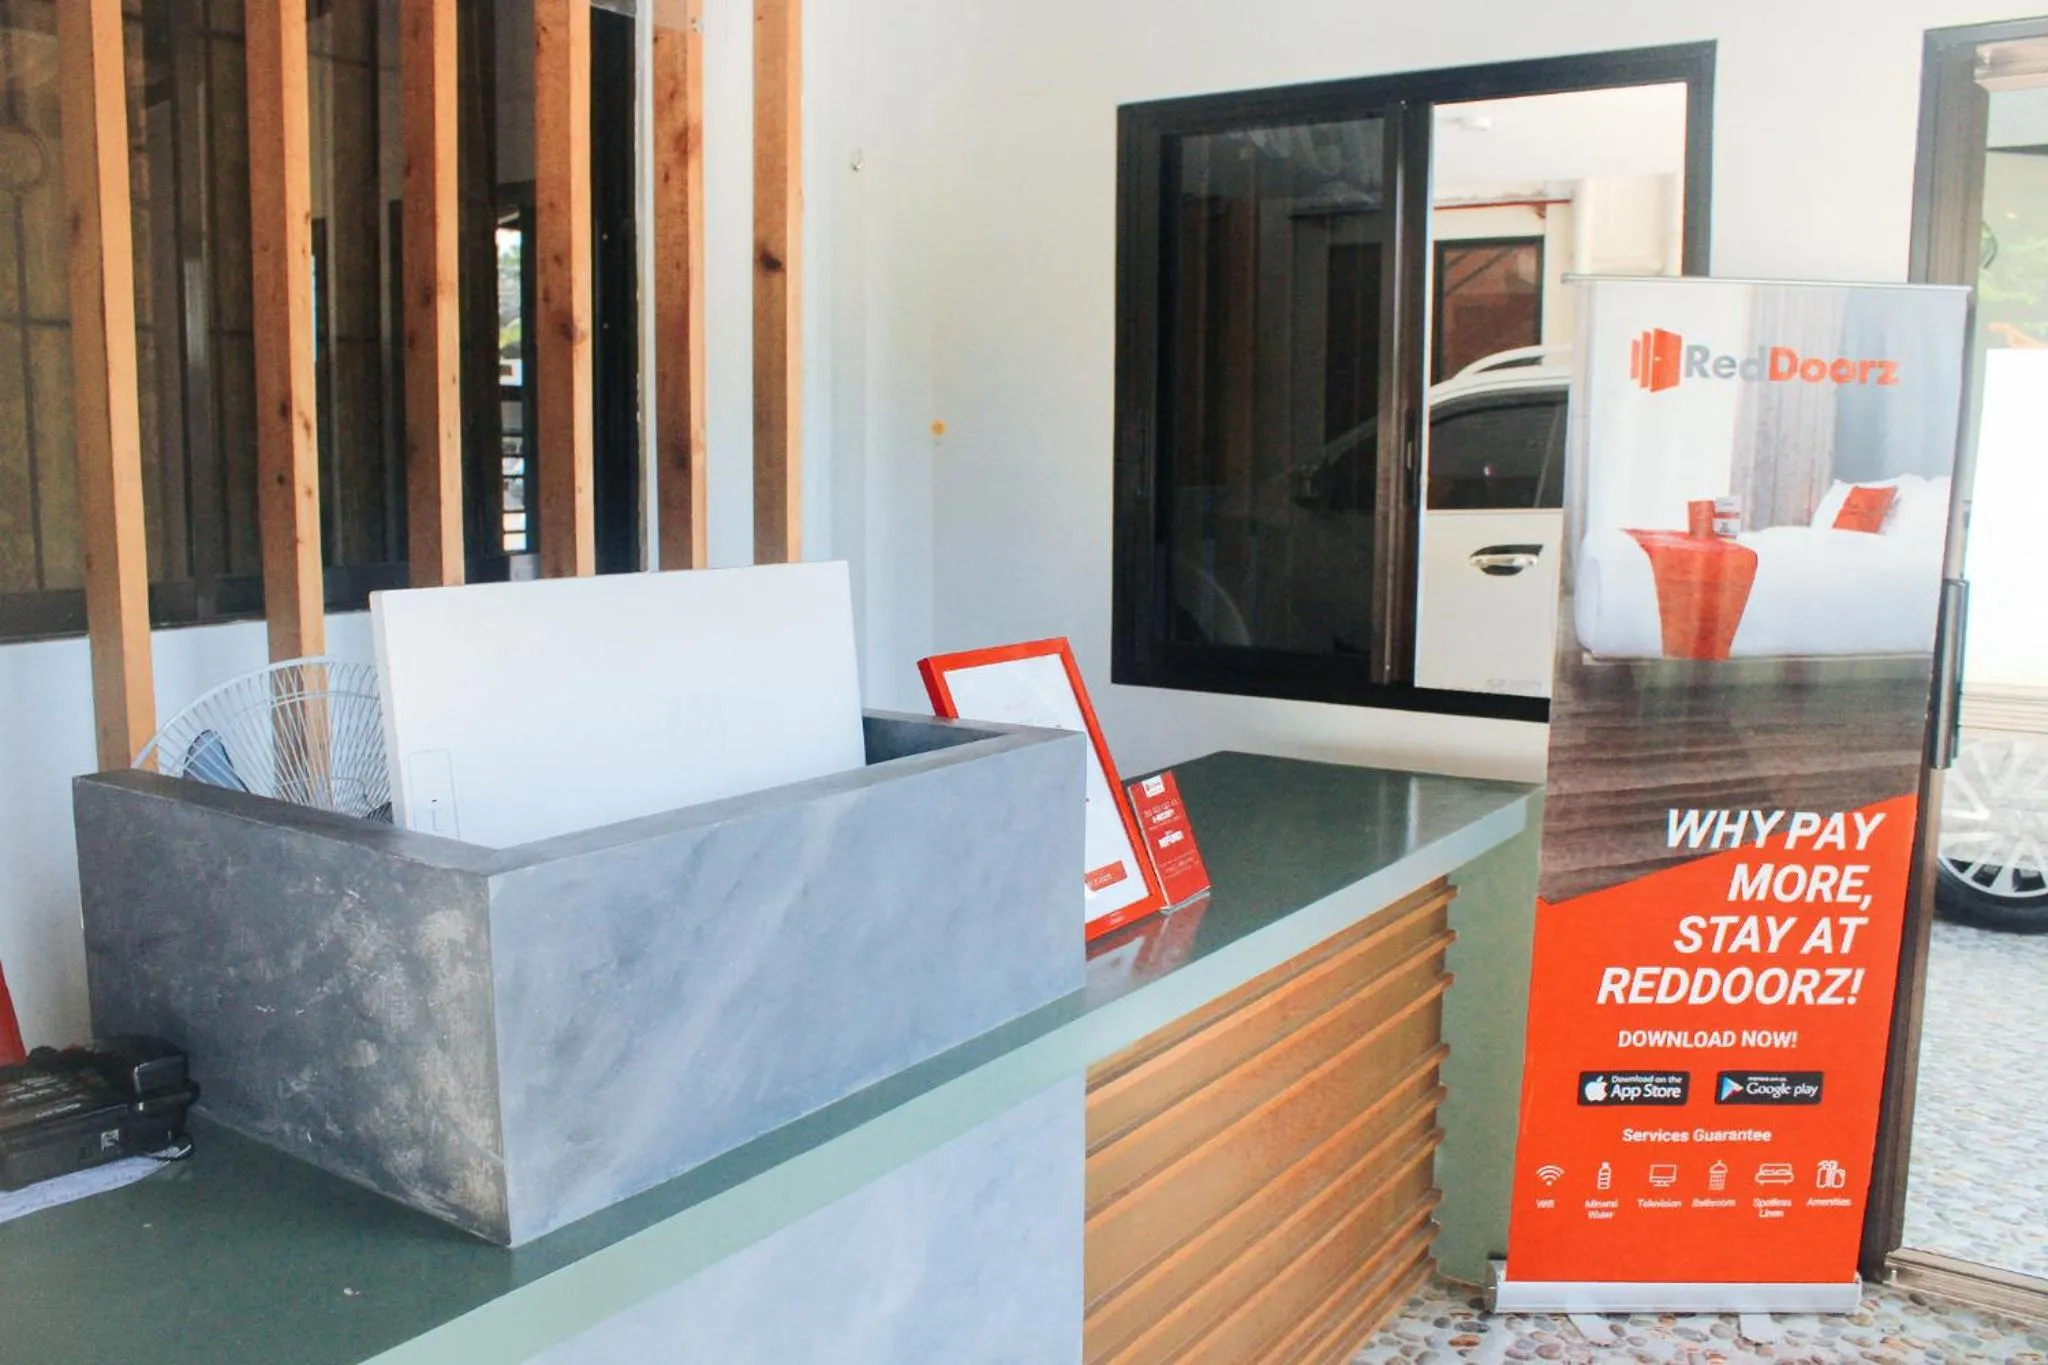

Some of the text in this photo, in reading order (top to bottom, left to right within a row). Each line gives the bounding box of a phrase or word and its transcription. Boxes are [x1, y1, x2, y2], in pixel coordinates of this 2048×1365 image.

[1685, 345, 1899, 385] RedDoorz
[1666, 808, 1886, 851] WHY PAY
[1727, 863, 1873, 911] MORE,
[1673, 915, 1869, 954] STAY AT
[1596, 966, 1865, 1006] REDDOORZ!
[1617, 1030, 1798, 1048] DOWNLOAD NOW!
[1610, 1083, 1682, 1101] App Store
[1611, 1075, 1653, 1083] Download
[1670, 1075, 1683, 1083] the
[1746, 1081, 1819, 1099] Google play
[1622, 1128, 1772, 1142] Services Guarantee
